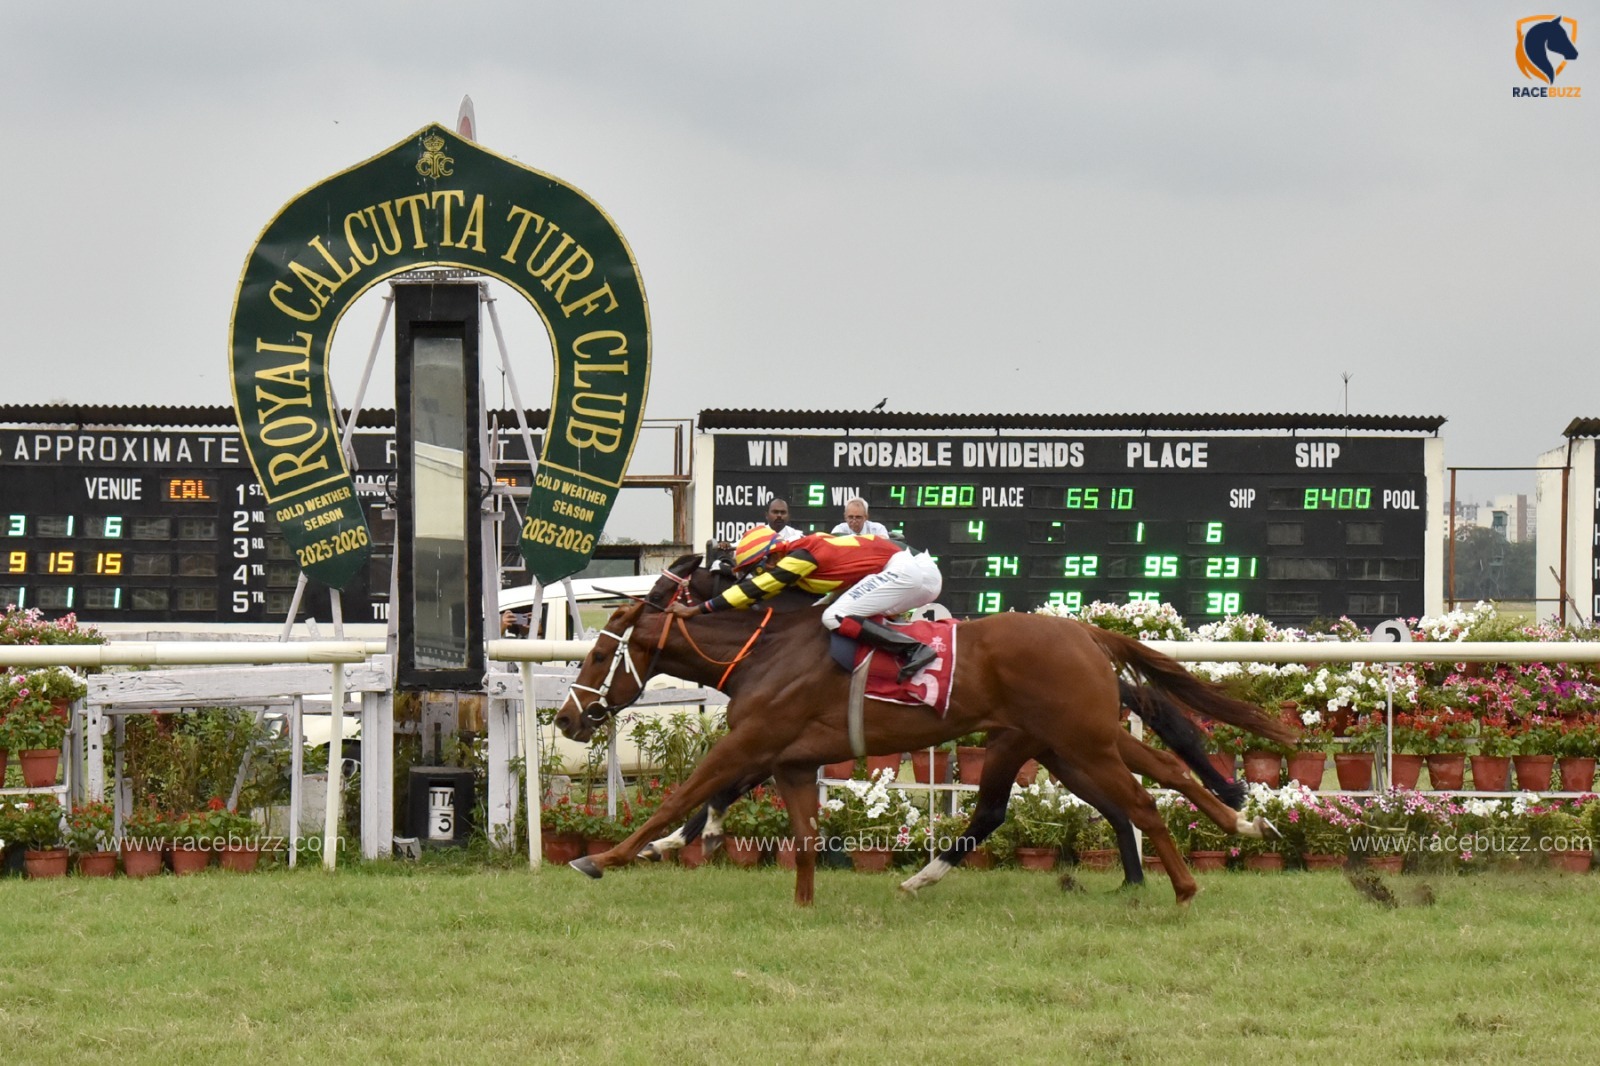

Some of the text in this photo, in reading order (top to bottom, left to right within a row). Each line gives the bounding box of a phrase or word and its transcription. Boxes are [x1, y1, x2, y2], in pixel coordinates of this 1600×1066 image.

[255, 189, 629, 486] ROYAL CALCUTTA TURF CLUB
[14, 435, 240, 464] APPROXIMATE
[747, 440, 788, 466] WIN
[833, 441, 1084, 470] PROBABLE DIVIDENDS
[1126, 442, 1208, 469] PLACE
[1295, 442, 1341, 468] SHP
[85, 477, 142, 500] VENUE
[169, 480, 210, 499] CAL
[535, 473, 561, 491] COLD
[561, 481, 607, 506] WEATHER
[715, 485, 753, 506] RACE
[808, 484, 825, 505] 5
[831, 486, 861, 506] WIN
[982, 486, 1025, 508] PLACE
[1229, 489, 1256, 509] SHP
[1303, 487, 1372, 509] 8400
[1383, 489, 1420, 510] POOL
[276, 486, 352, 522] COLD WEATHER
[552, 500, 594, 522] SEASON
[8, 514, 122, 537] 3 1 6
[303, 507, 344, 531] SEASON
[521, 516, 594, 555] 2025-2026
[715, 521, 766, 543] HOR
[968, 520, 984, 541] 4
[1136, 522, 1144, 543] 1
[1206, 522, 1223, 543] 6
[295, 525, 369, 567] 2025-2026
[9, 552, 122, 574] 9 15 15
[1064, 555, 1098, 577] 52
[1144, 555, 1178, 577] 95
[18, 586, 121, 609] 1 1 1
[977, 592, 1001, 613] 13
[1206, 592, 1240, 613] 38
